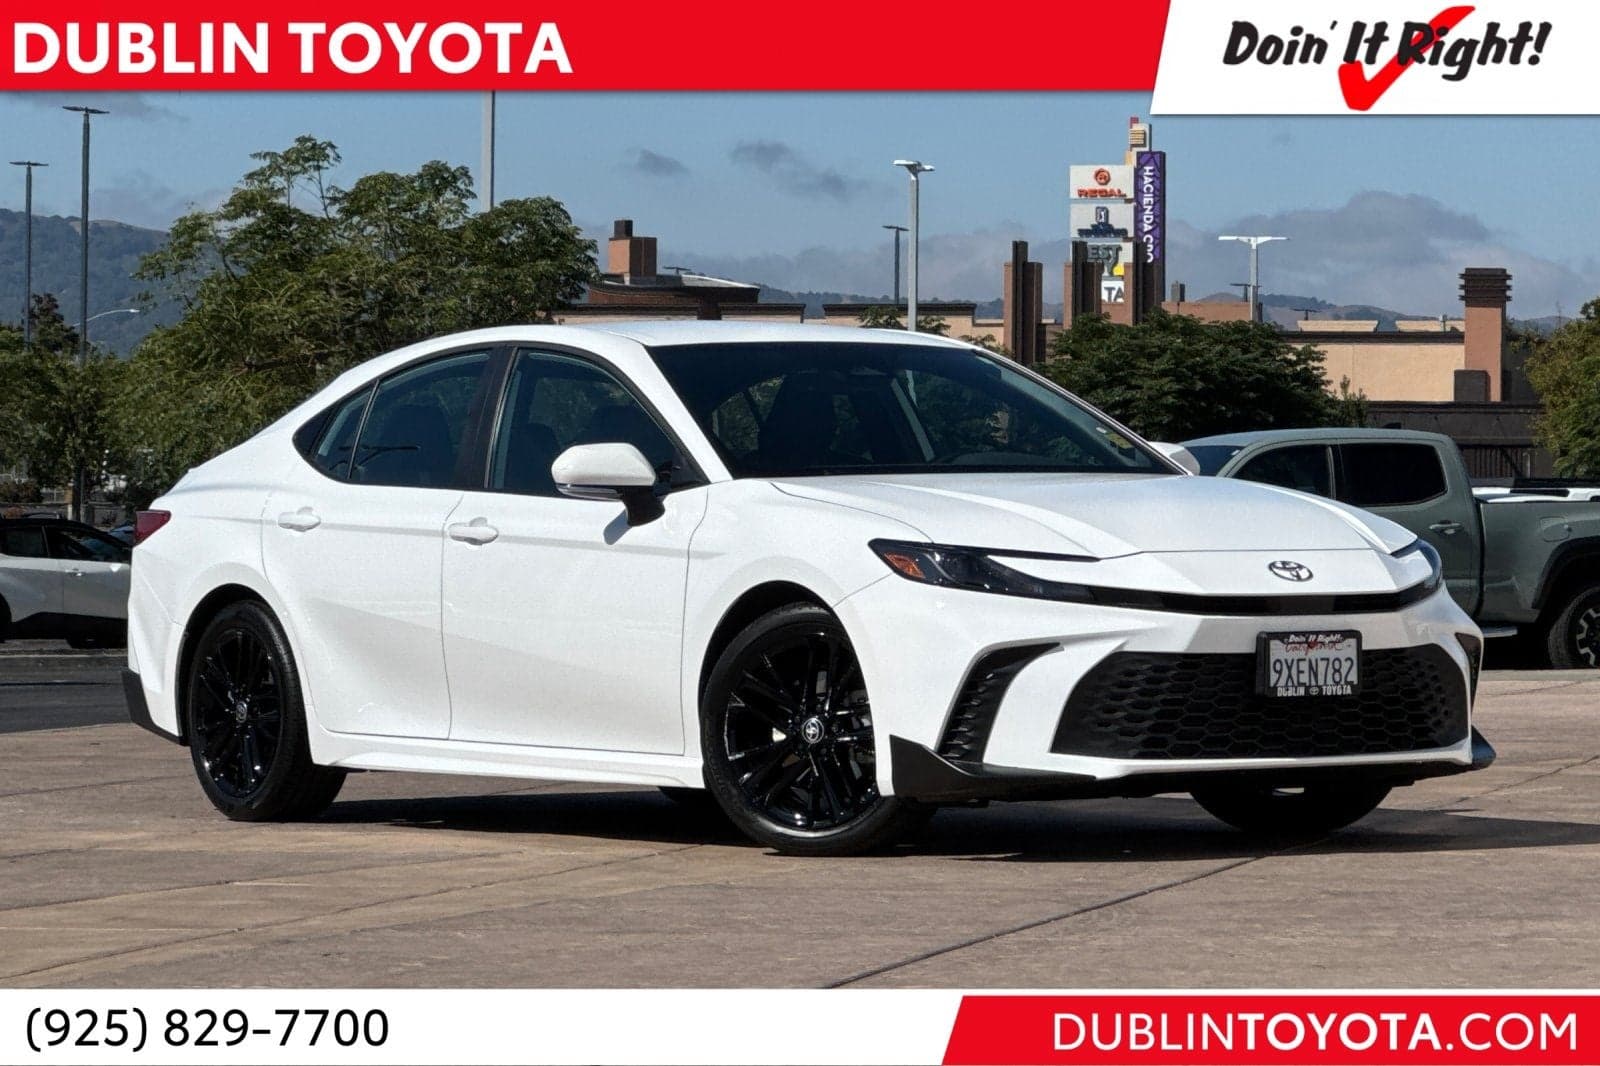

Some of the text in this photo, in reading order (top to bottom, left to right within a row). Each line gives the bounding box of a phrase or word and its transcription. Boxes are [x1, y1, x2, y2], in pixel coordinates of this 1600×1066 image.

[1142, 166, 1154, 232] HACIENDA
[1272, 657, 1355, 688] 9XEN782
[1277, 684, 1352, 697] DUBLIN TOYOTA
